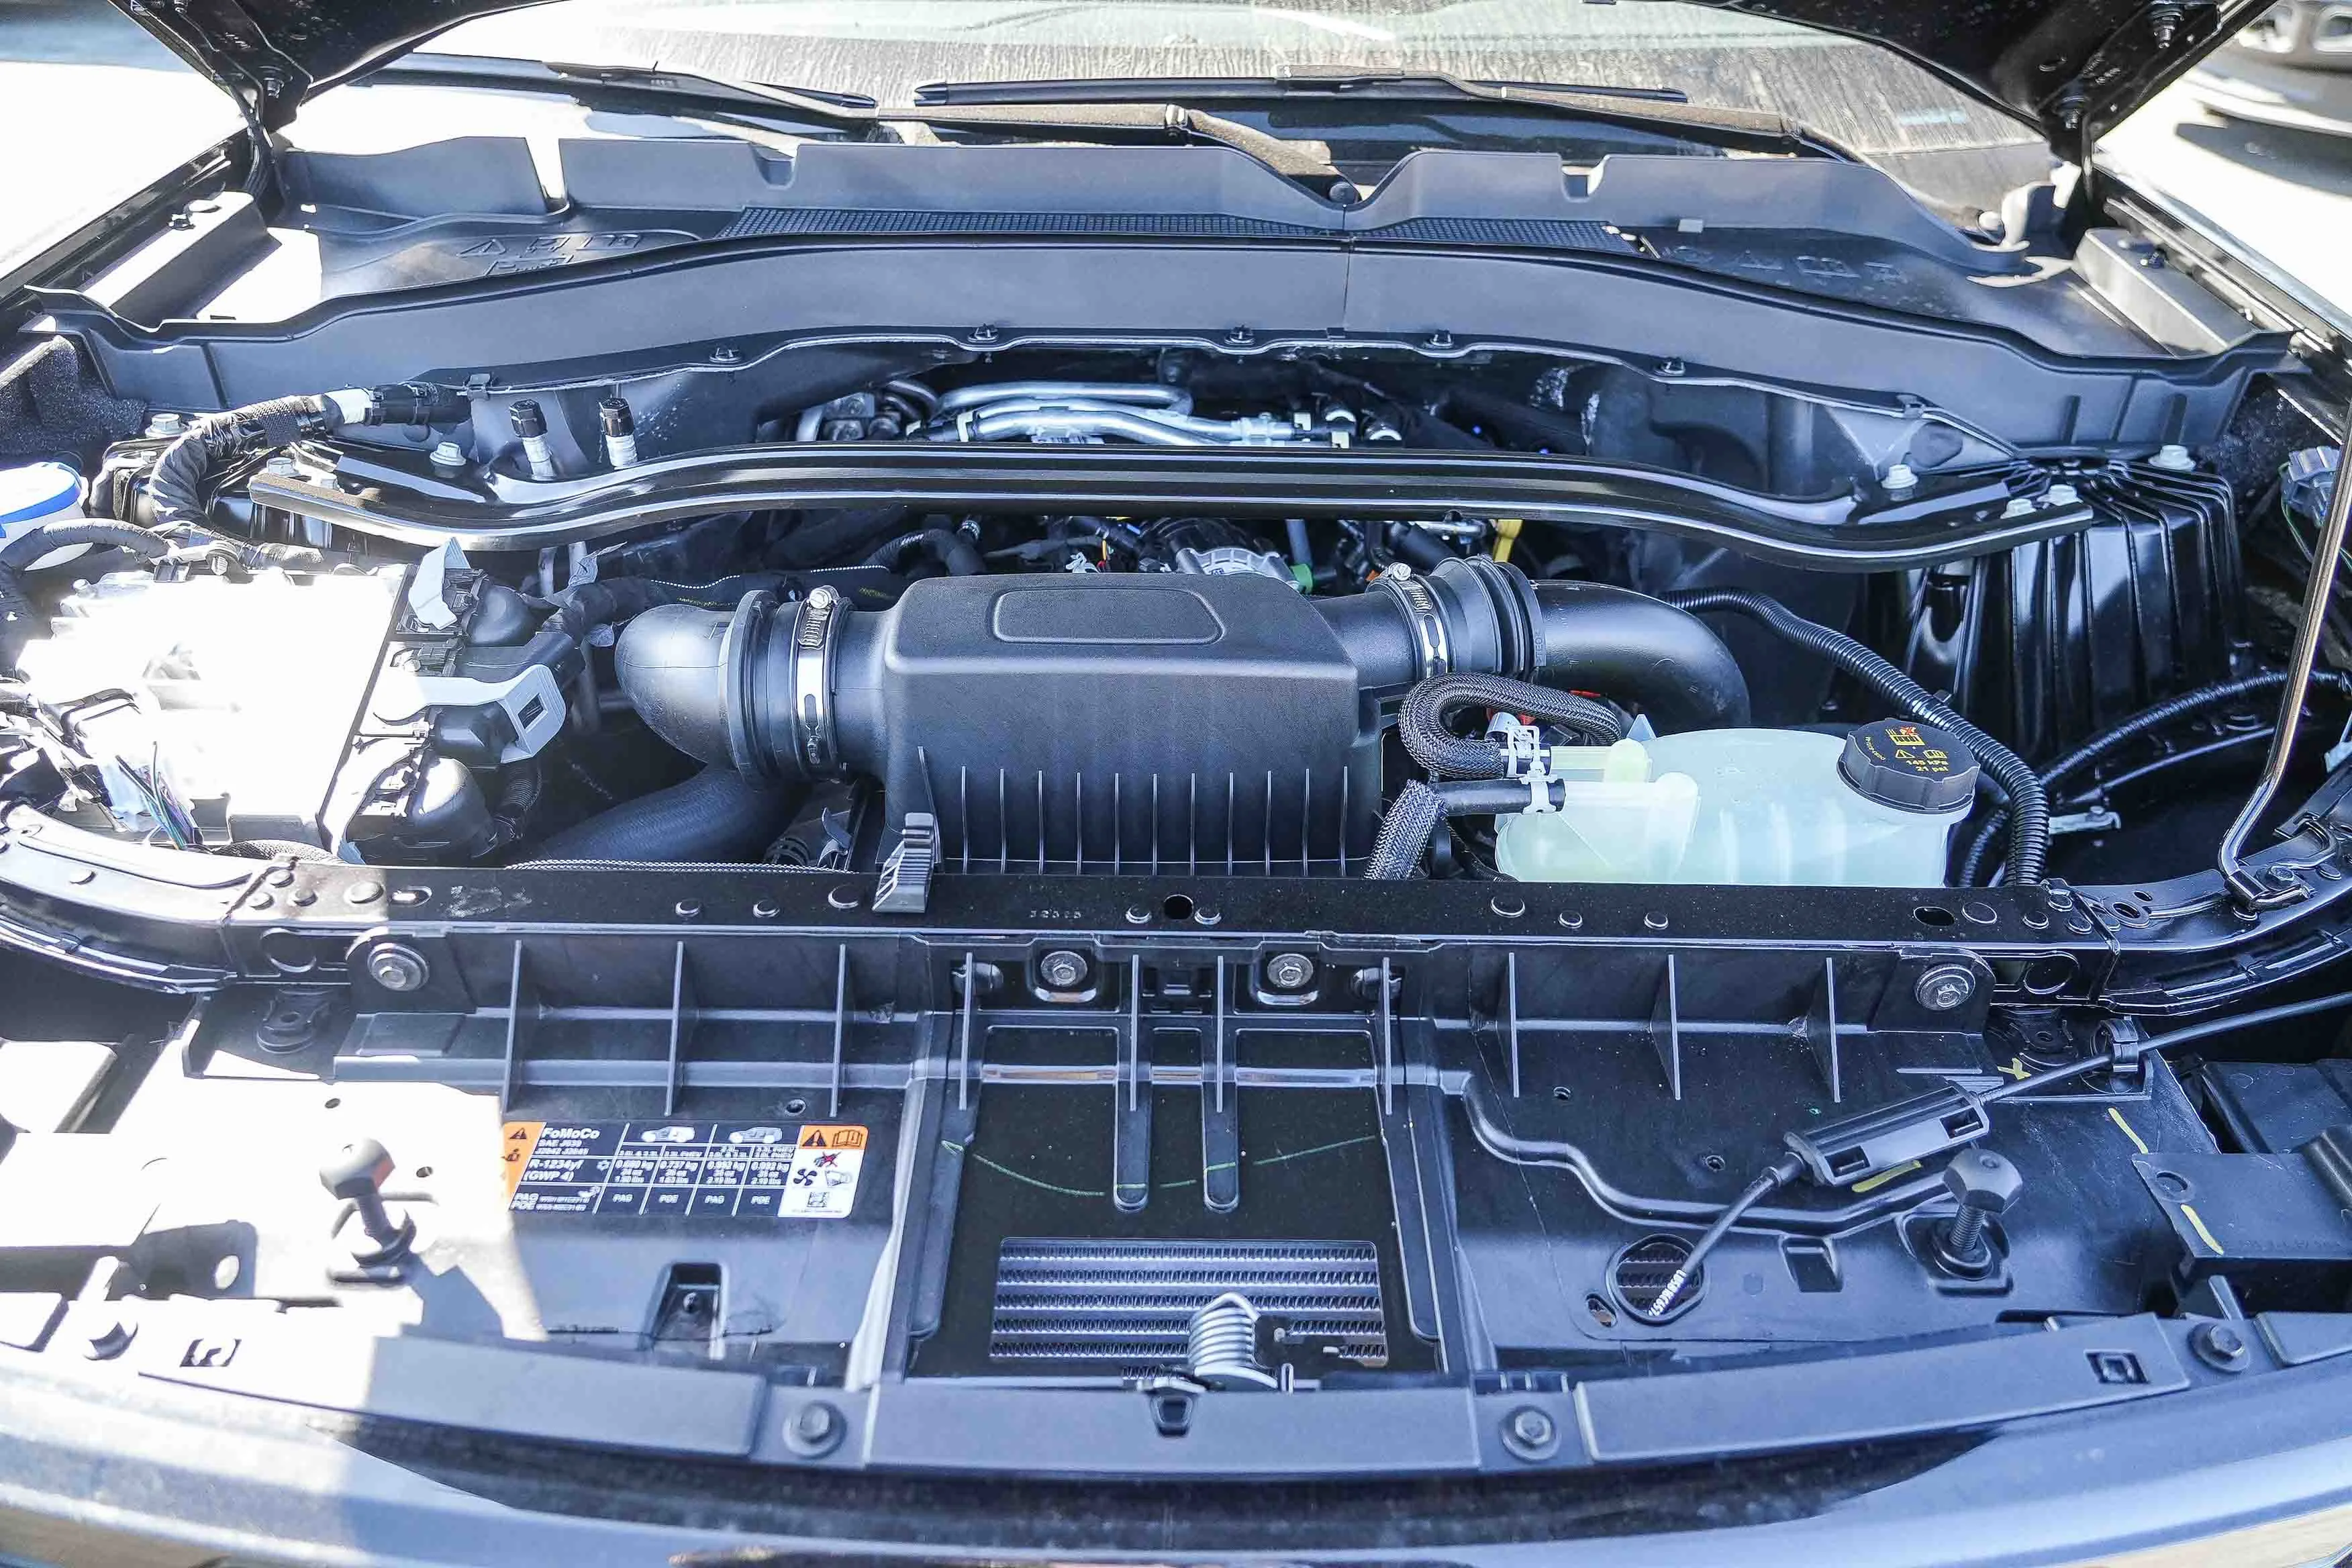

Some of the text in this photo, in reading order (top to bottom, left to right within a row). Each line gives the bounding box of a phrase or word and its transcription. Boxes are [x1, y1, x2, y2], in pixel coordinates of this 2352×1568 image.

[542, 1128, 601, 1139] FoMoCo
[538, 1139, 559, 1147] SAE
[641, 1160, 655, 1171] kg
[685, 1161, 699, 1171] kg
[732, 1161, 746, 1171] kg
[777, 1162, 791, 1173] kg
[524, 1171, 575, 1182] (GWP 4)
[513, 1193, 539, 1202] PAG
[613, 1193, 633, 1202] PAG
[659, 1194, 679, 1203] POE
[705, 1195, 725, 1204] PAG
[751, 1195, 771, 1204] POE
[509, 1201, 536, 1210] POE
